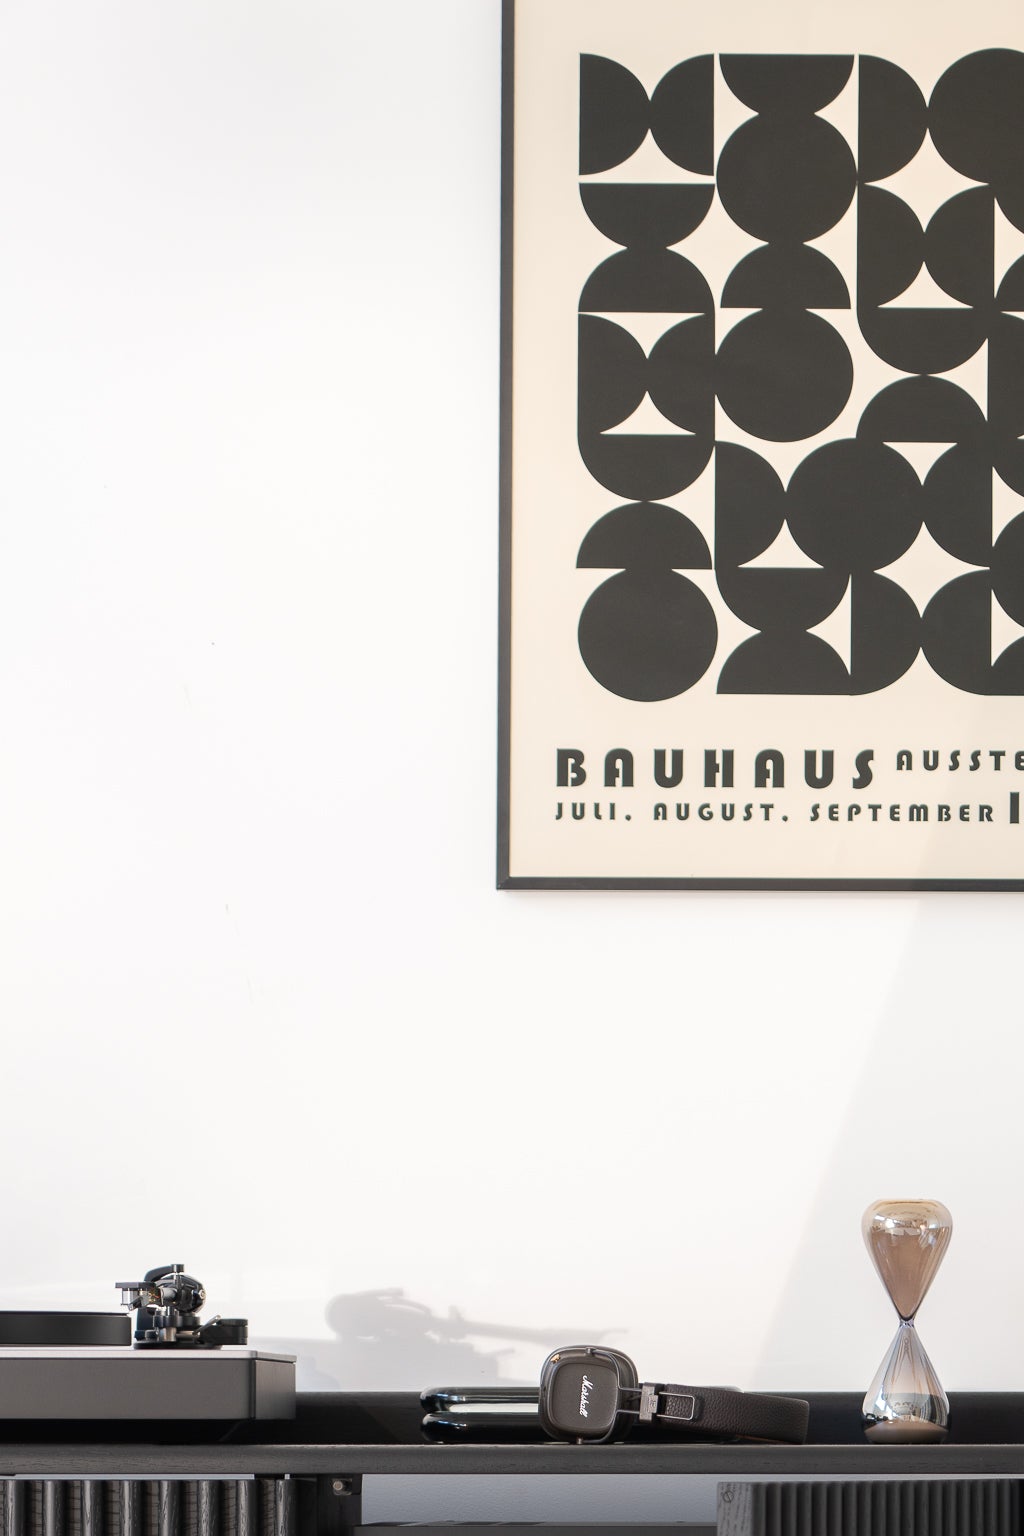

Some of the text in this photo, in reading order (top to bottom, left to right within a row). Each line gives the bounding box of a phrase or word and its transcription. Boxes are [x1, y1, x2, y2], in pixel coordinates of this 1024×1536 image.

[556, 748, 874, 790] BAUHAUS
[810, 803, 994, 822] SEPTEMBER
[579, 1374, 594, 1418] Marshall
